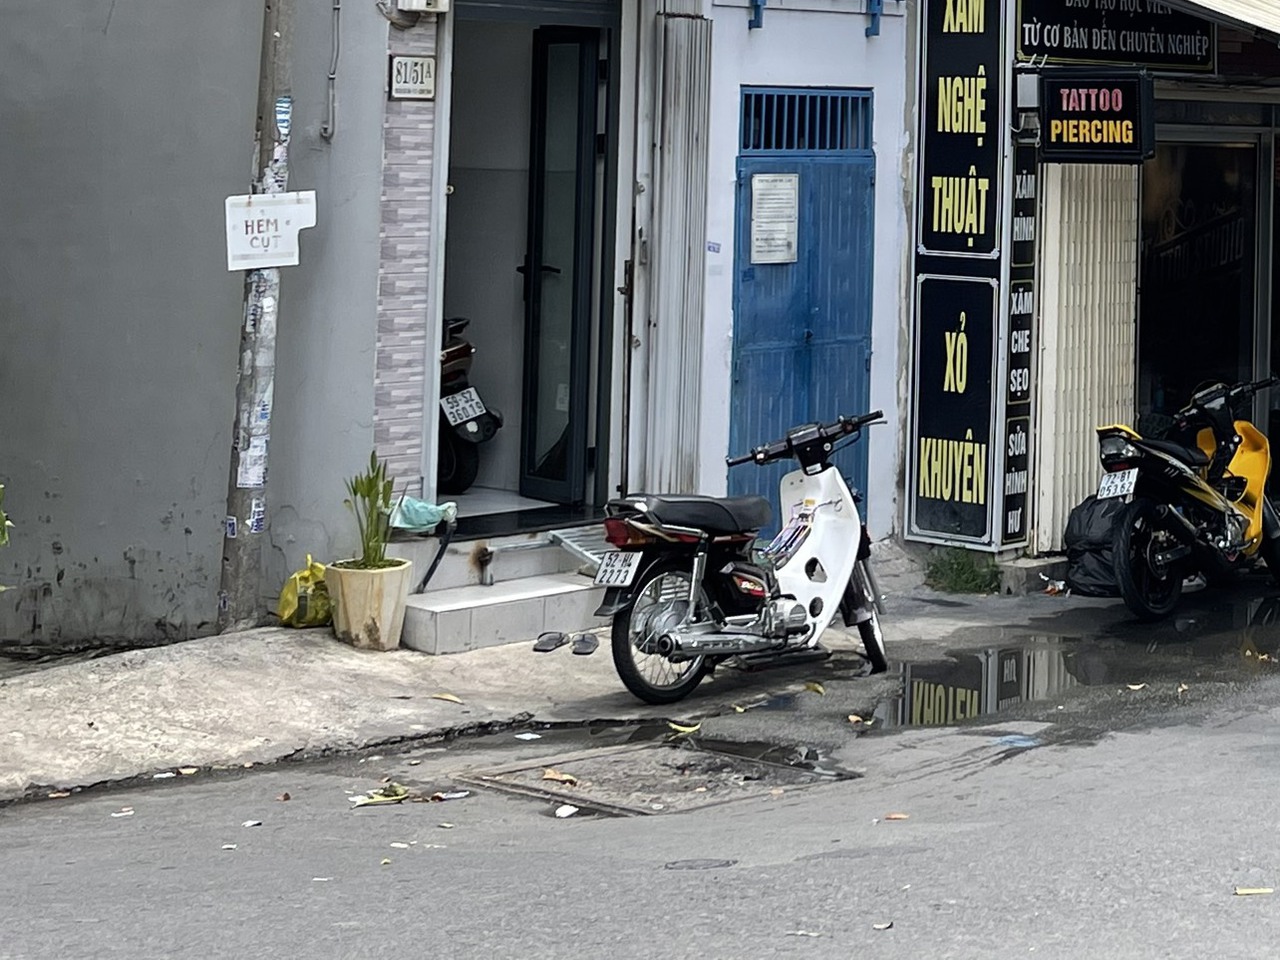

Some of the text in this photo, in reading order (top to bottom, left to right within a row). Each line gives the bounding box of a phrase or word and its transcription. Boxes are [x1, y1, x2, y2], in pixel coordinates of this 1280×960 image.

[1022, 17, 1209, 61] TỪ CƠ BẢN ĐẾN CHUYÊN NGHIỆP
[937, 65, 987, 147] NGHỆ
[1060, 88, 1123, 112] TATTOO
[1050, 119, 1133, 144] PIERCING
[931, 165, 989, 247] THUẬT
[1010, 287, 1033, 315] XĂM
[943, 311, 968, 394] XỎ
[1011, 330, 1030, 353] CHE
[1010, 368, 1029, 397] SẸO
[919, 428, 986, 505] KHUYÊN
[1007, 506, 1022, 534] HƯ
[599, 568, 629, 584] 2273
